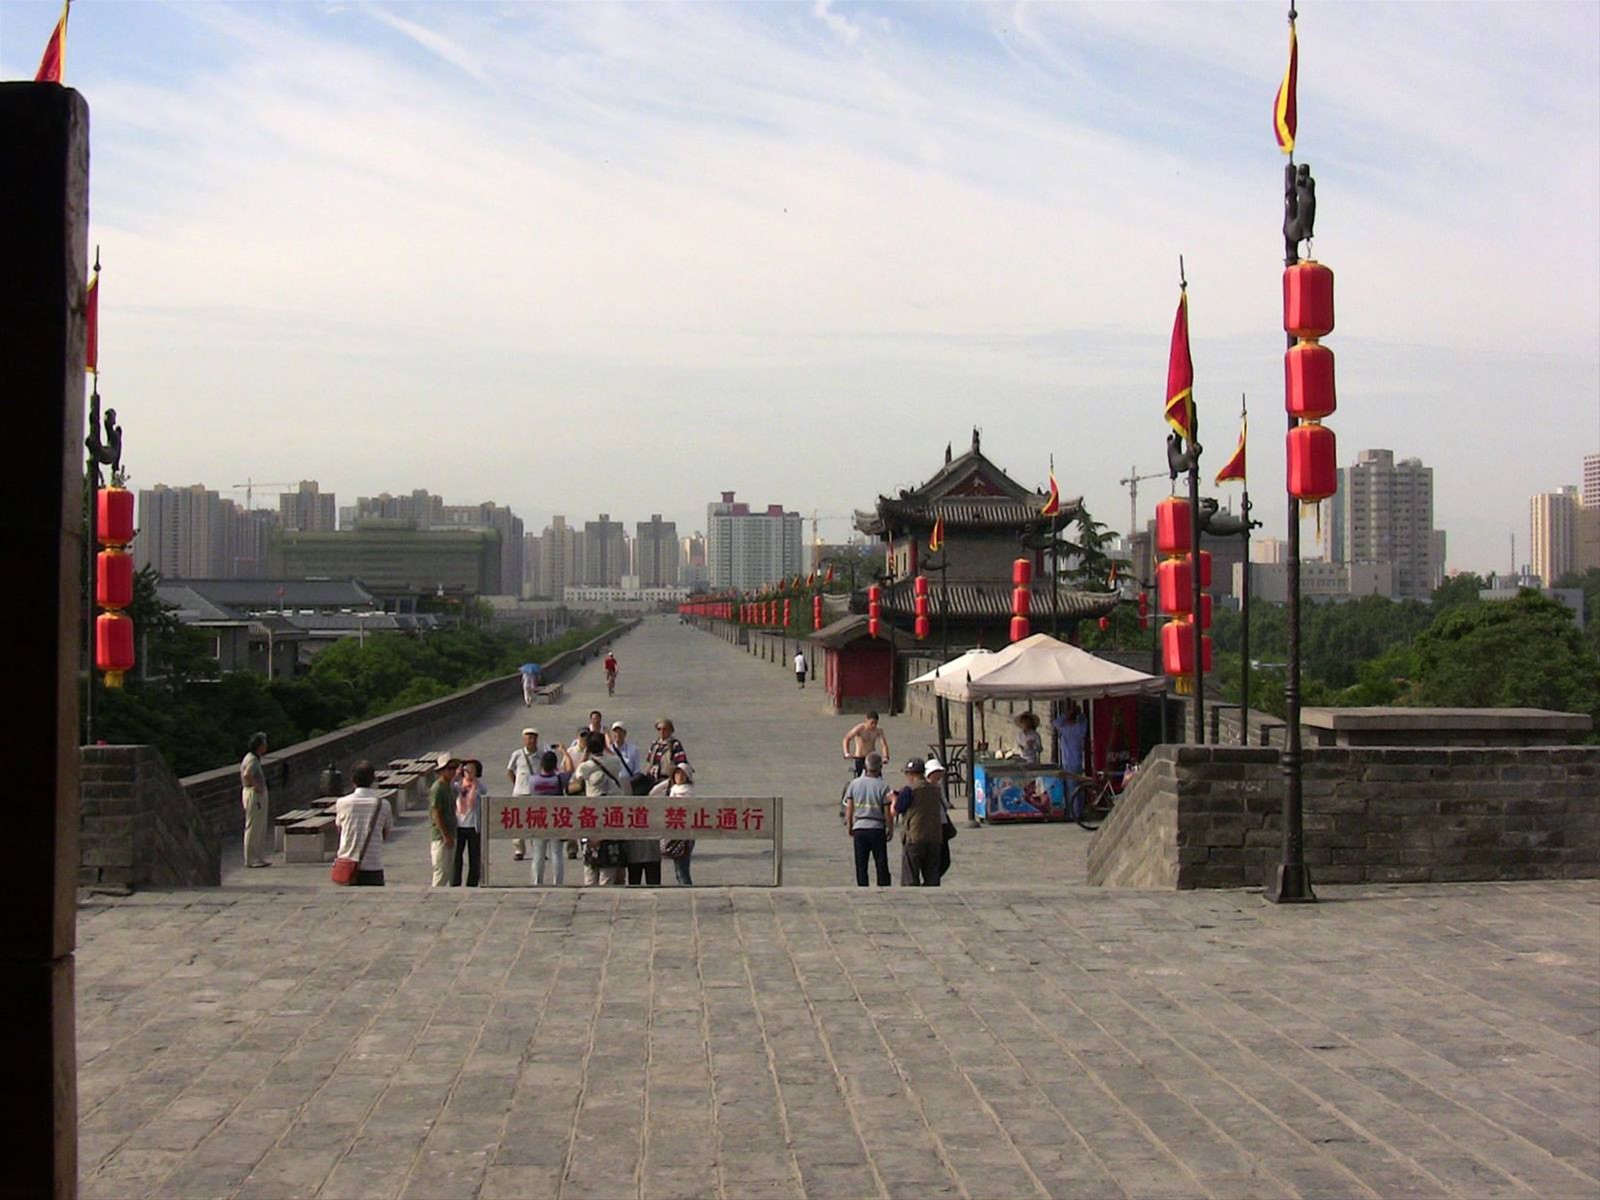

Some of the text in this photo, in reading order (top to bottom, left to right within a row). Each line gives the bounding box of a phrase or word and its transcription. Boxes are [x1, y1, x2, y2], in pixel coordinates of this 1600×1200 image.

[501, 806, 764, 830] 机械设备通道 禁止通行
